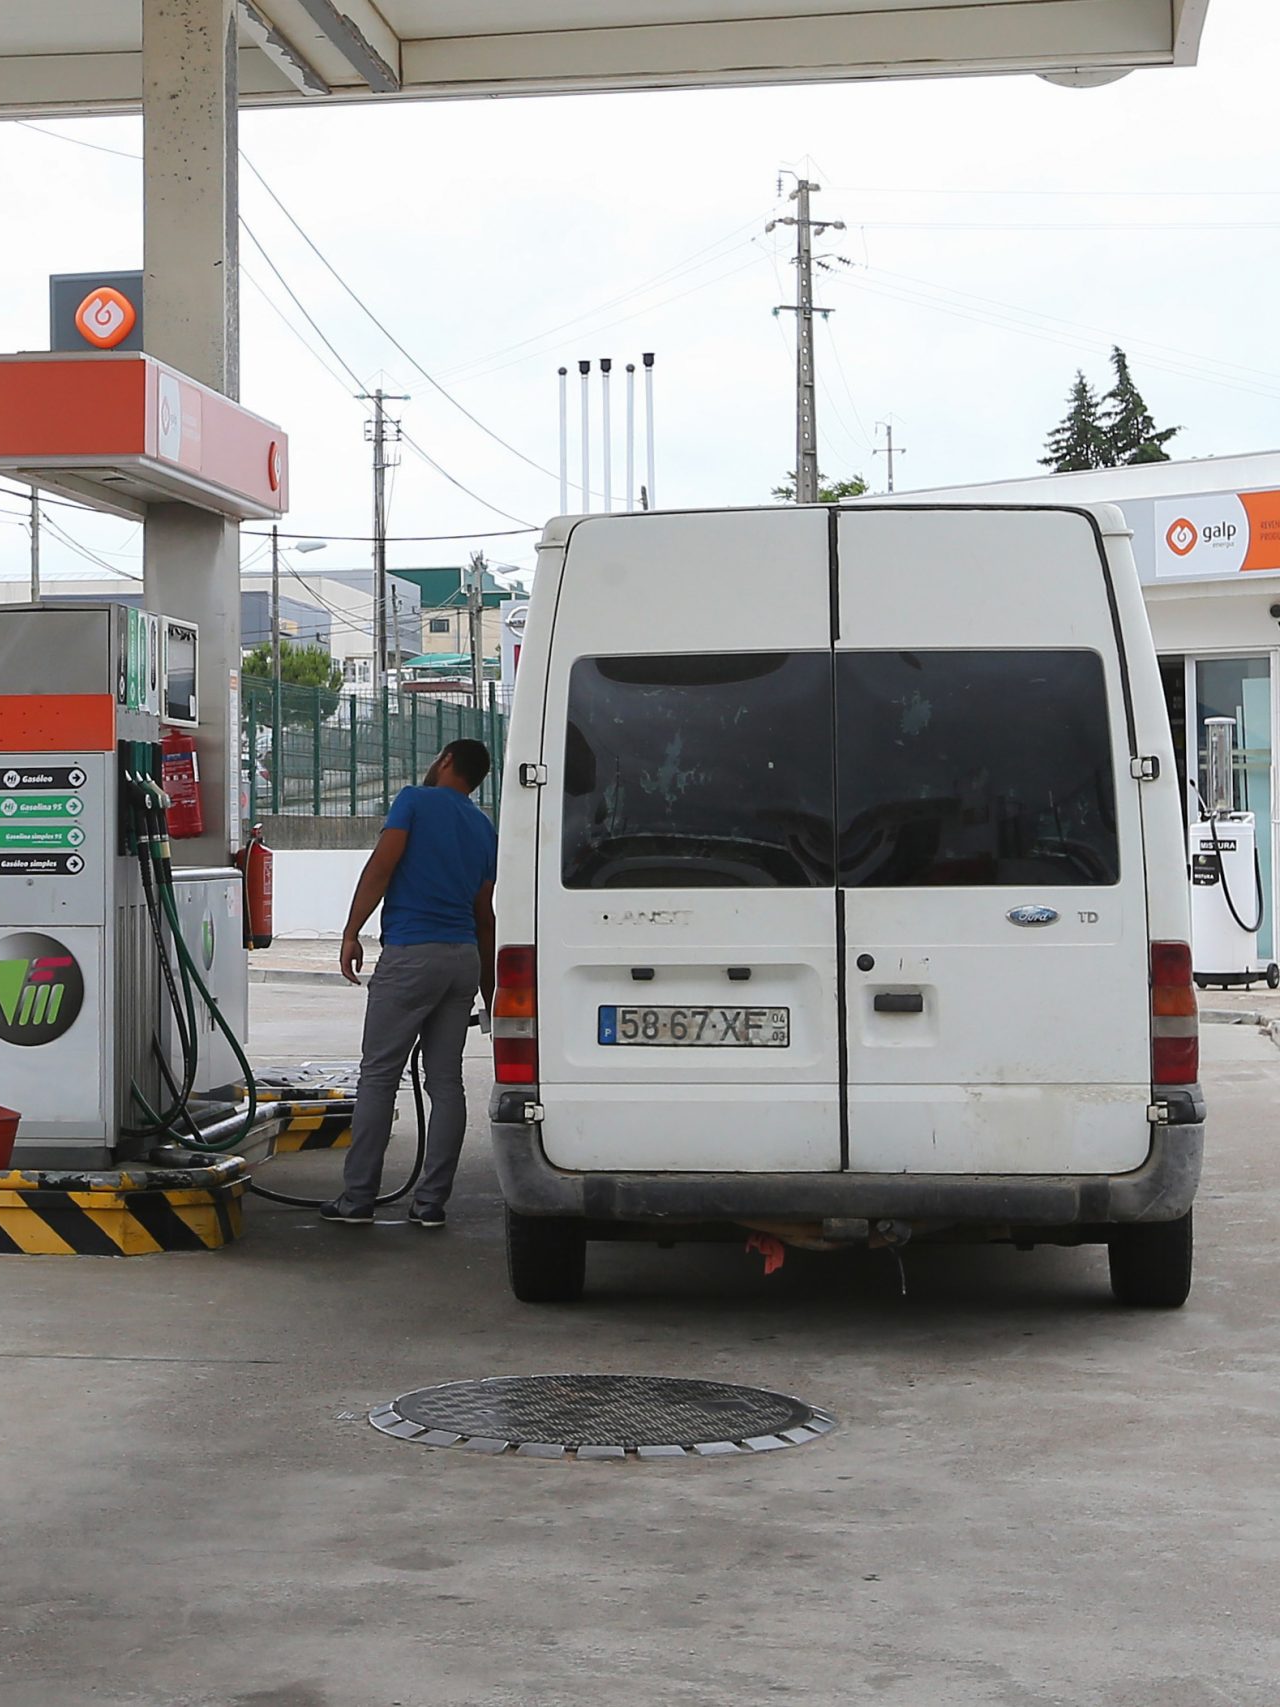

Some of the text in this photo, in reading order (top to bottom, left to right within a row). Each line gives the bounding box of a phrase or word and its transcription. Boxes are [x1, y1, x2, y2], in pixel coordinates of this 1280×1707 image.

[1202, 521, 1237, 543] galp
[22, 774, 53, 783] Gasóleo
[20, 803, 52, 811] Gasolina
[52, 803, 63, 811] 95
[1, 859, 57, 869] Gasóleo simples
[1077, 911, 1099, 924] TD
[772, 1013, 786, 1025] 04
[604, 1028, 612, 1038] P
[772, 1030, 786, 1042] 03
